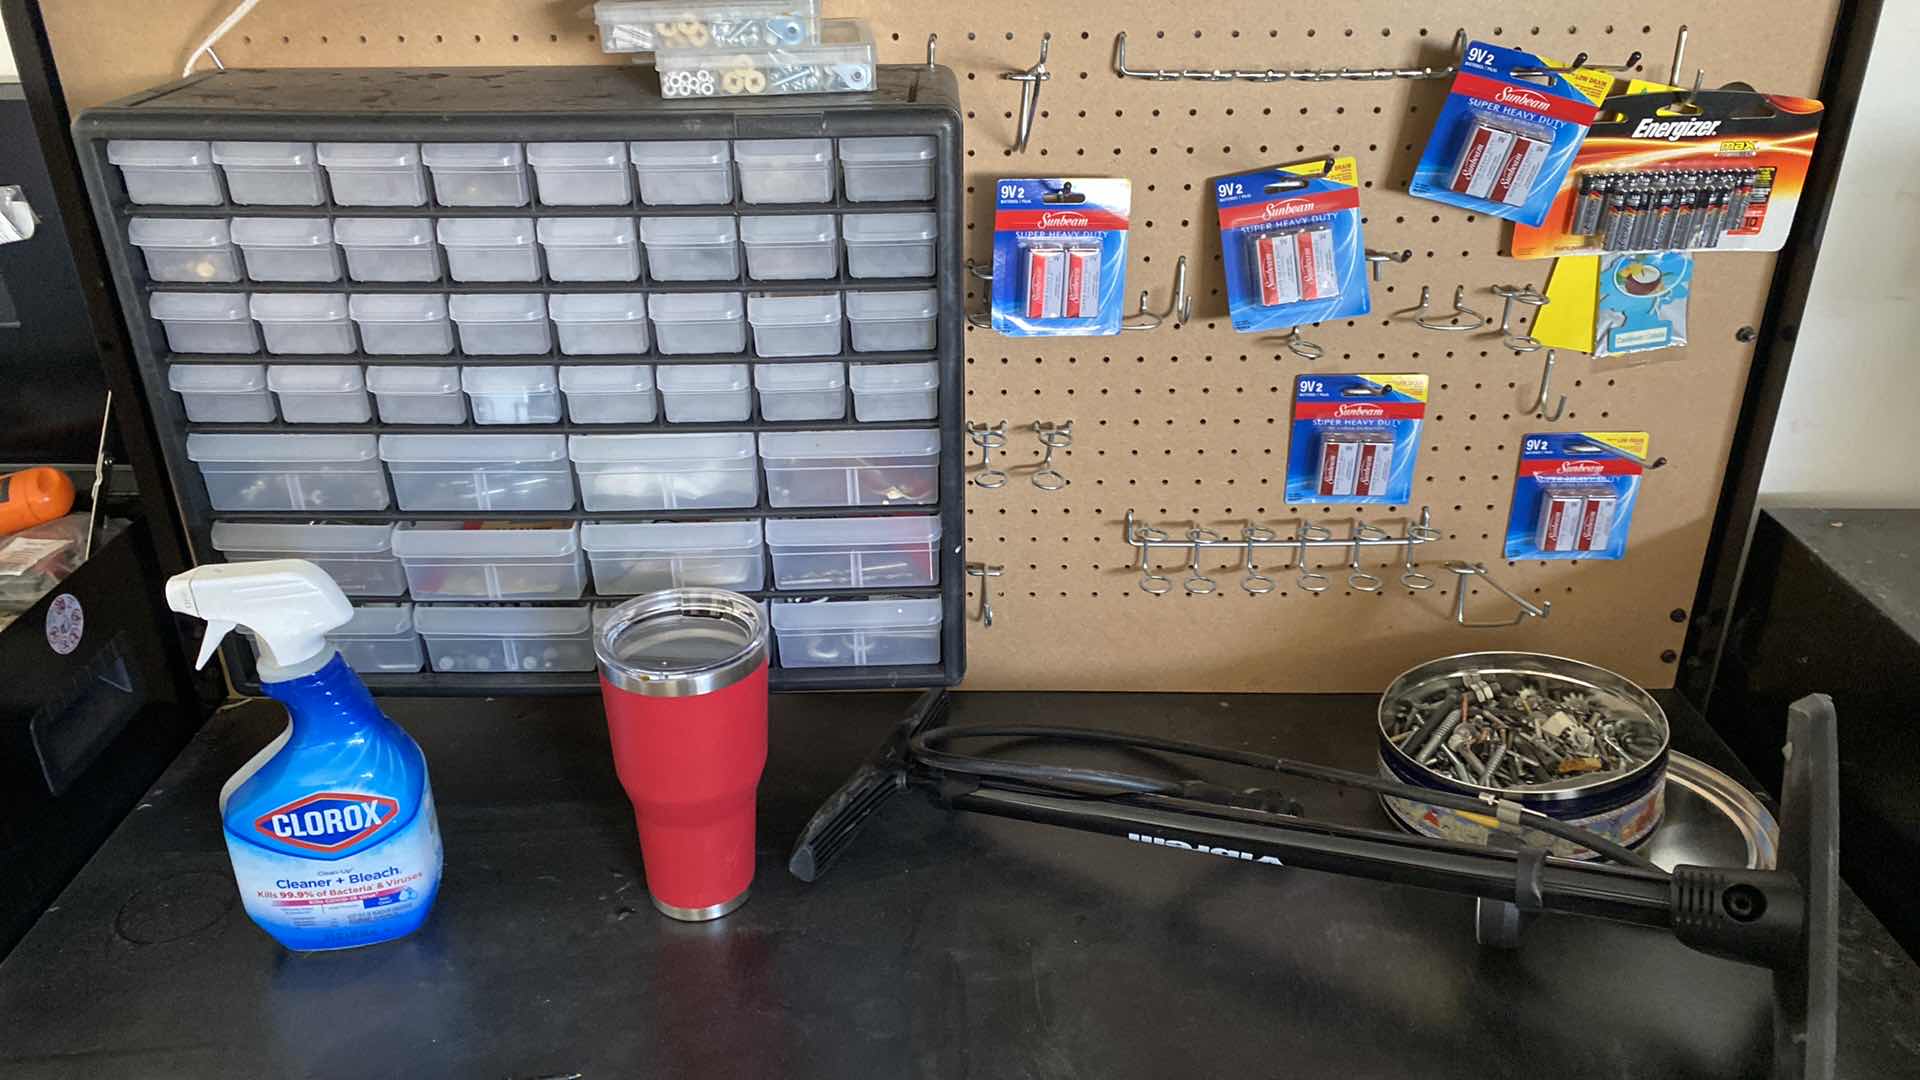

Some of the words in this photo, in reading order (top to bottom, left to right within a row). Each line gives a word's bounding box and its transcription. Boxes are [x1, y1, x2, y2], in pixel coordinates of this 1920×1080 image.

[1468, 47, 1488, 63] 9V
[1484, 54, 1495, 66] 2
[1495, 86, 1550, 112] Sunbeam
[1467, 97, 1501, 112] SUPER
[1502, 106, 1537, 121] HEAVY
[1538, 115, 1567, 131] DUTY
[1632, 117, 1721, 141] Energizer
[1000, 184, 1017, 199] 9V
[1017, 187, 1025, 198] 2
[1218, 182, 1234, 198] 9V
[1234, 183, 1244, 195] 2
[1262, 198, 1315, 221] Sunbeam
[1037, 212, 1089, 230] Sunbeam
[1240, 222, 1273, 234] SUPER
[1275, 217, 1308, 229] HEAVY
[1311, 211, 1338, 223] DUTY
[1015, 231, 1046, 240] SUPER
[1049, 231, 1080, 240] HEAVY
[1300, 380, 1316, 393] 9V
[1315, 382, 1324, 392] 2
[1334, 403, 1384, 418] Sunbeam
[1312, 418, 1341, 426] SUPER
[1344, 418, 1375, 426] HEAVY
[1377, 418, 1401, 427] DUTY
[1526, 439, 1541, 451] 9V
[1541, 441, 1548, 450] 2
[1556, 460, 1605, 474] Sunbeam
[271, 799, 383, 838] CLOROX
[257, 890, 277, 898] Kills
[279, 889, 314, 898] 99.9%
[377, 881, 385, 889] &
[385, 872, 423, 887] Viruses
[276, 879, 331, 889] Cleaner
[336, 877, 344, 885] +
[349, 866, 400, 884] Bleach
